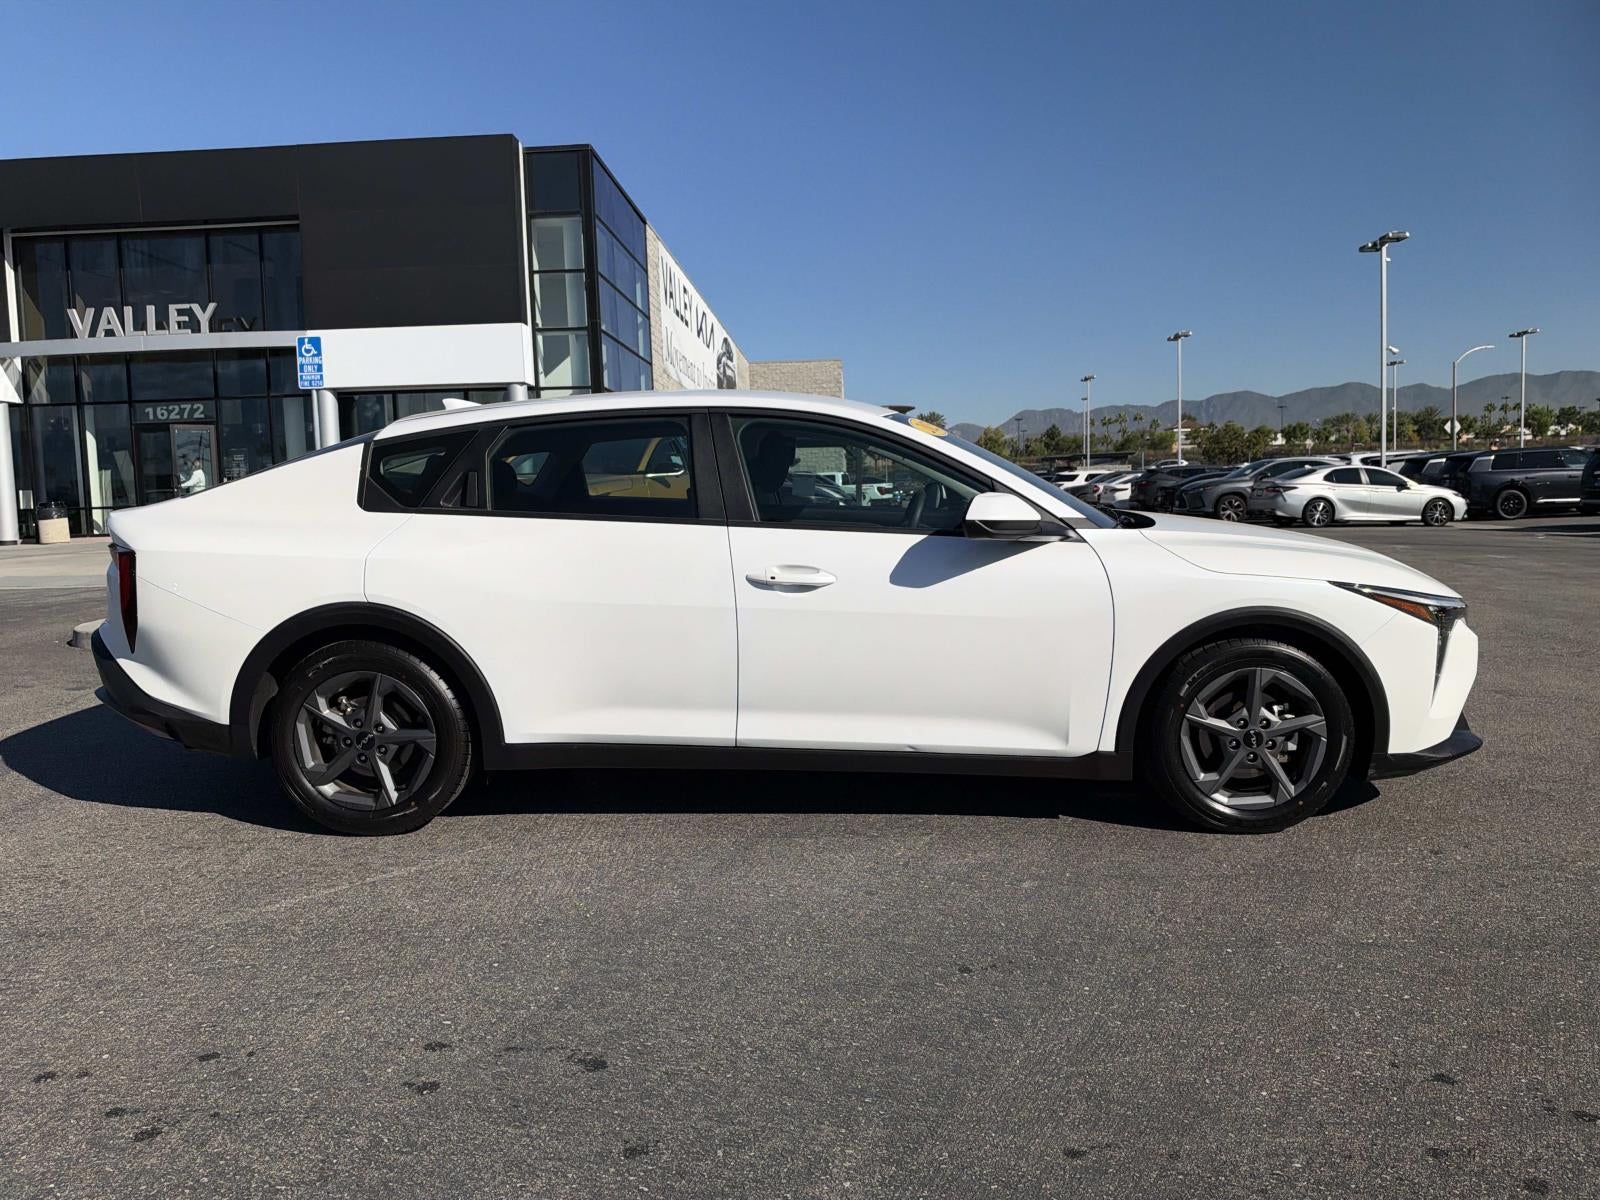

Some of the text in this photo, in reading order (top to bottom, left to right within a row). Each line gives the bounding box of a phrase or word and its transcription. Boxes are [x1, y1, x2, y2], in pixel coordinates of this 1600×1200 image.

[661, 255, 692, 333] VALLEY
[67, 302, 217, 339] VALLEY
[299, 356, 323, 365] PARKING
[303, 365, 318, 373] ONLY
[145, 403, 205, 420] 16272
